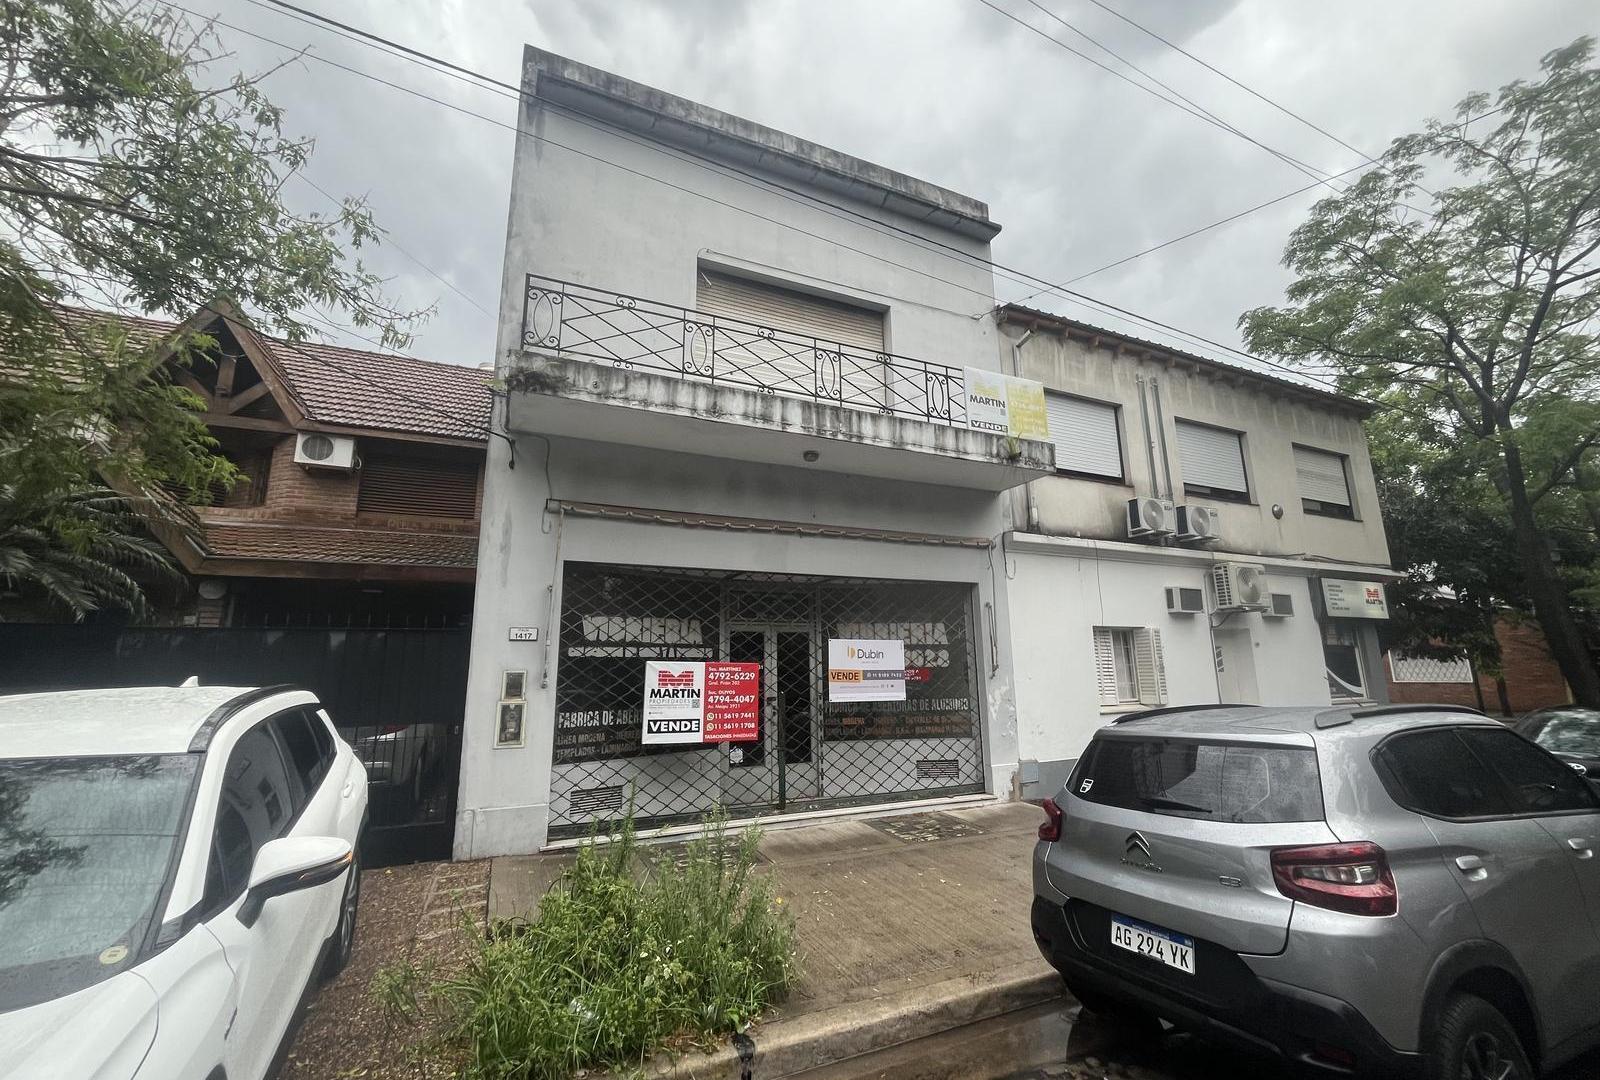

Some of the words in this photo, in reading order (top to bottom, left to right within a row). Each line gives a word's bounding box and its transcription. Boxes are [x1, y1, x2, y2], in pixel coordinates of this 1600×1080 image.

[970, 395, 1006, 408] MARTIN
[972, 421, 1008, 432] VENDE
[857, 648, 884, 659] Dubin
[708, 672, 755, 680] 4792-6229
[831, 671, 859, 680] VENDE
[649, 688, 701, 699] MARTIN
[708, 695, 755, 704] 4794-4047
[558, 711, 600, 728] FABRICA
[602, 710, 614, 726] DE
[649, 720, 700, 733] VENDE
[1115, 925, 1132, 947] AG
[1136, 933, 1164, 960] 294
[1169, 943, 1189, 969] YK
